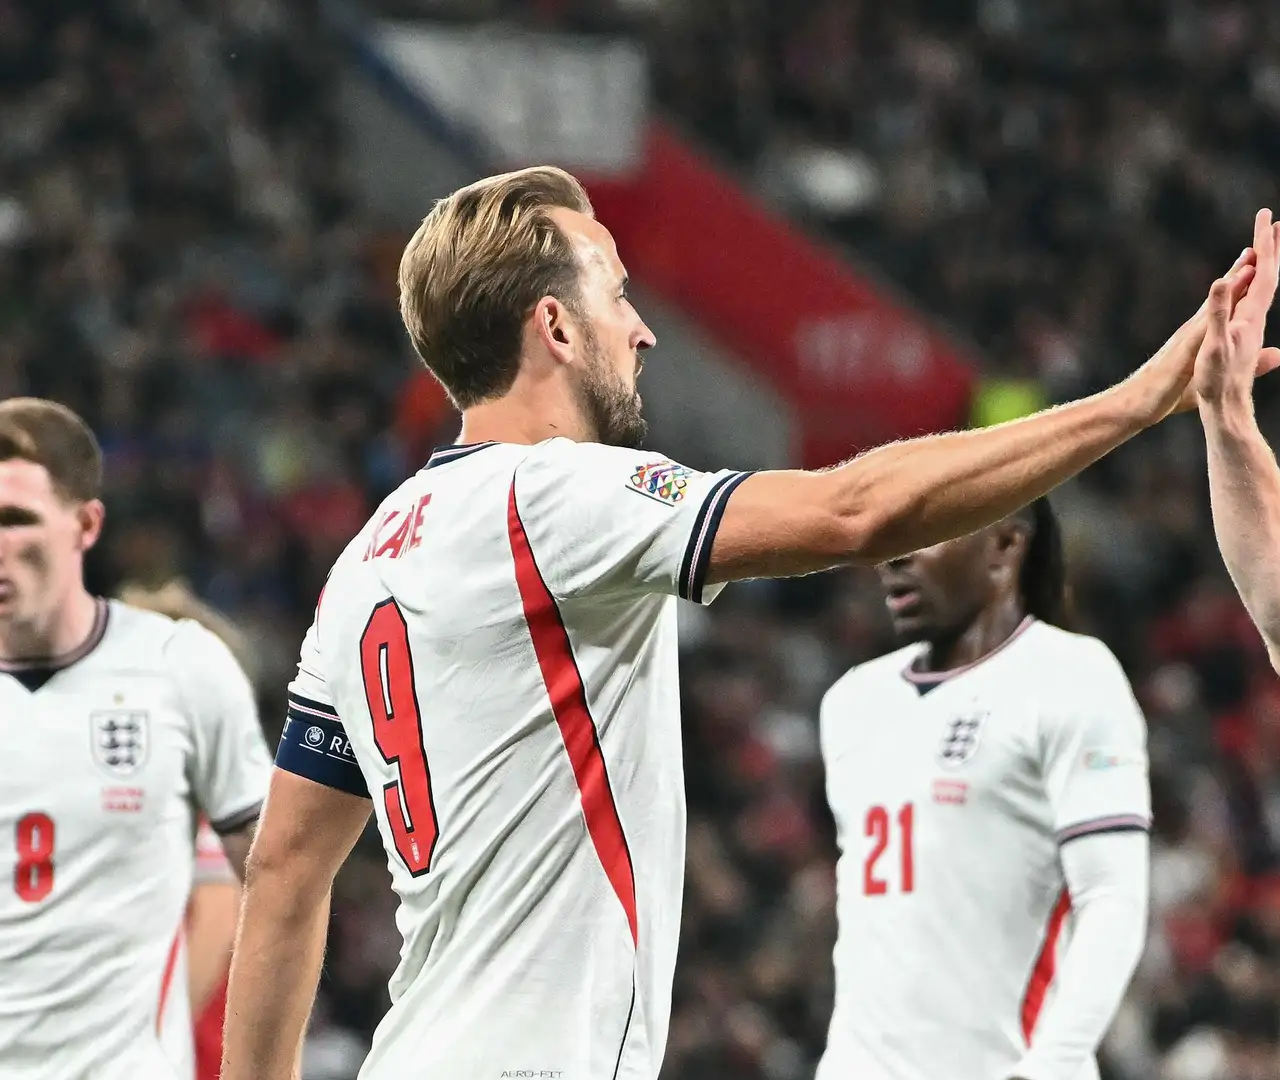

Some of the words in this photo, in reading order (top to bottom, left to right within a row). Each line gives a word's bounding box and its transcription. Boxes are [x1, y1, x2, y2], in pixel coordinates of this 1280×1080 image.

[362, 493, 432, 562] KAE
[359, 596, 440, 878] 9
[14, 811, 56, 904] 8
[862, 802, 916, 897] 21
